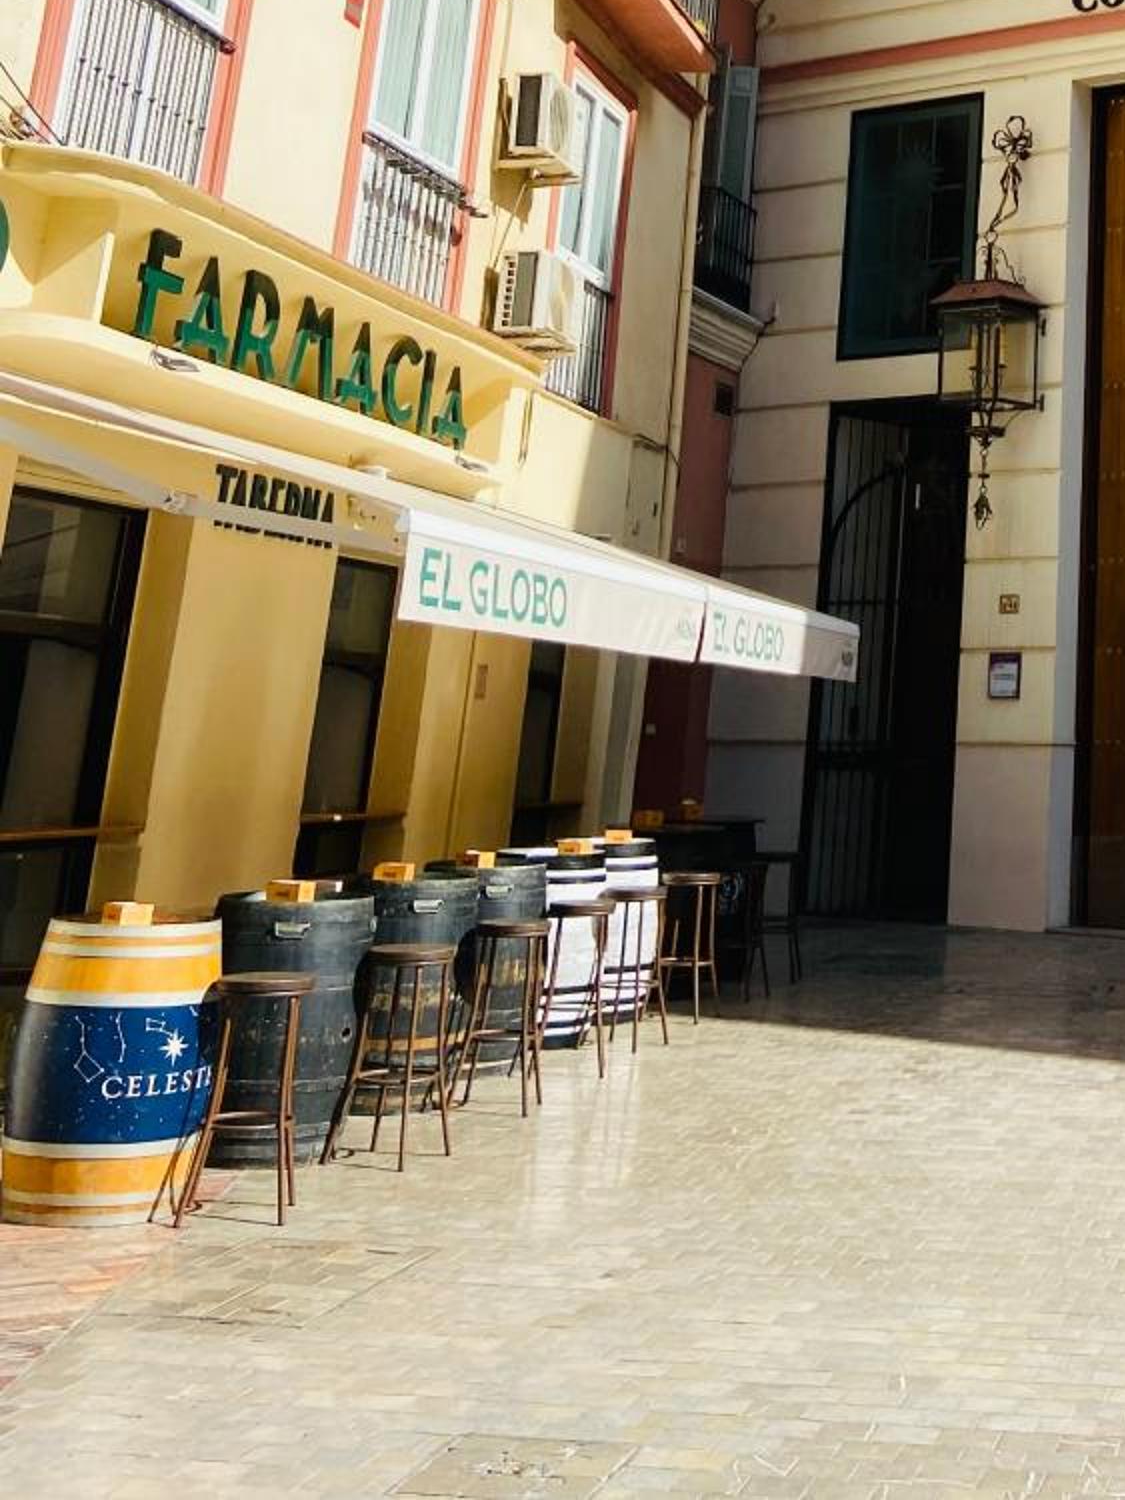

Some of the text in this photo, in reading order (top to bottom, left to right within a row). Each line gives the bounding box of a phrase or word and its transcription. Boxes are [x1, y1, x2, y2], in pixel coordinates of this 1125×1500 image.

[132, 227, 468, 451] FARMACIA
[419, 546, 568, 628] EL GLOBO
[733, 614, 785, 662] GLOBO
